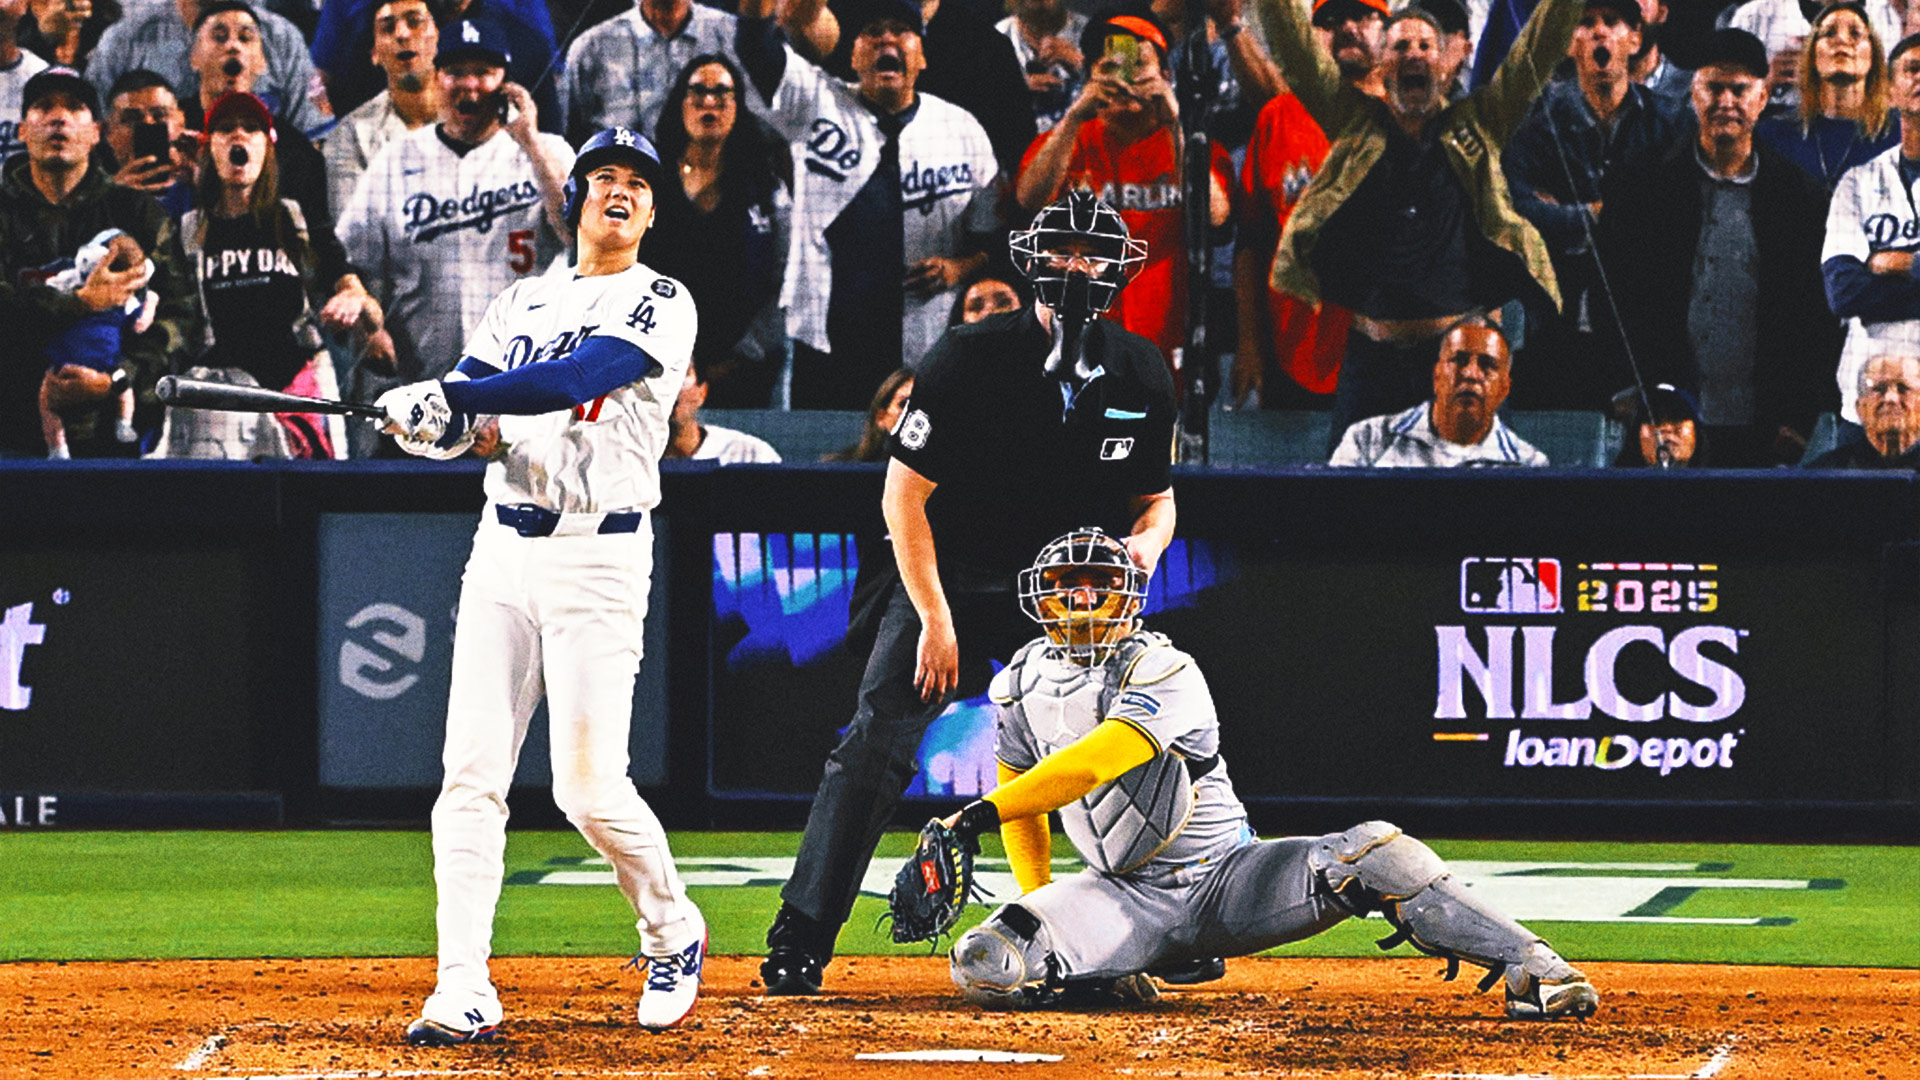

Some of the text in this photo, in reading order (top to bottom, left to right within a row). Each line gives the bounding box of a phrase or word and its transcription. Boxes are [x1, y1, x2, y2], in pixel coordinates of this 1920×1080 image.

[614, 126, 636, 147] LA
[402, 180, 540, 236] Dodgers
[508, 229, 537, 275] 5
[626, 296, 656, 334] LA
[1577, 580, 1718, 612] 2025
[1434, 625, 1746, 722] NLCS
[1504, 729, 1738, 776] loanDepot
